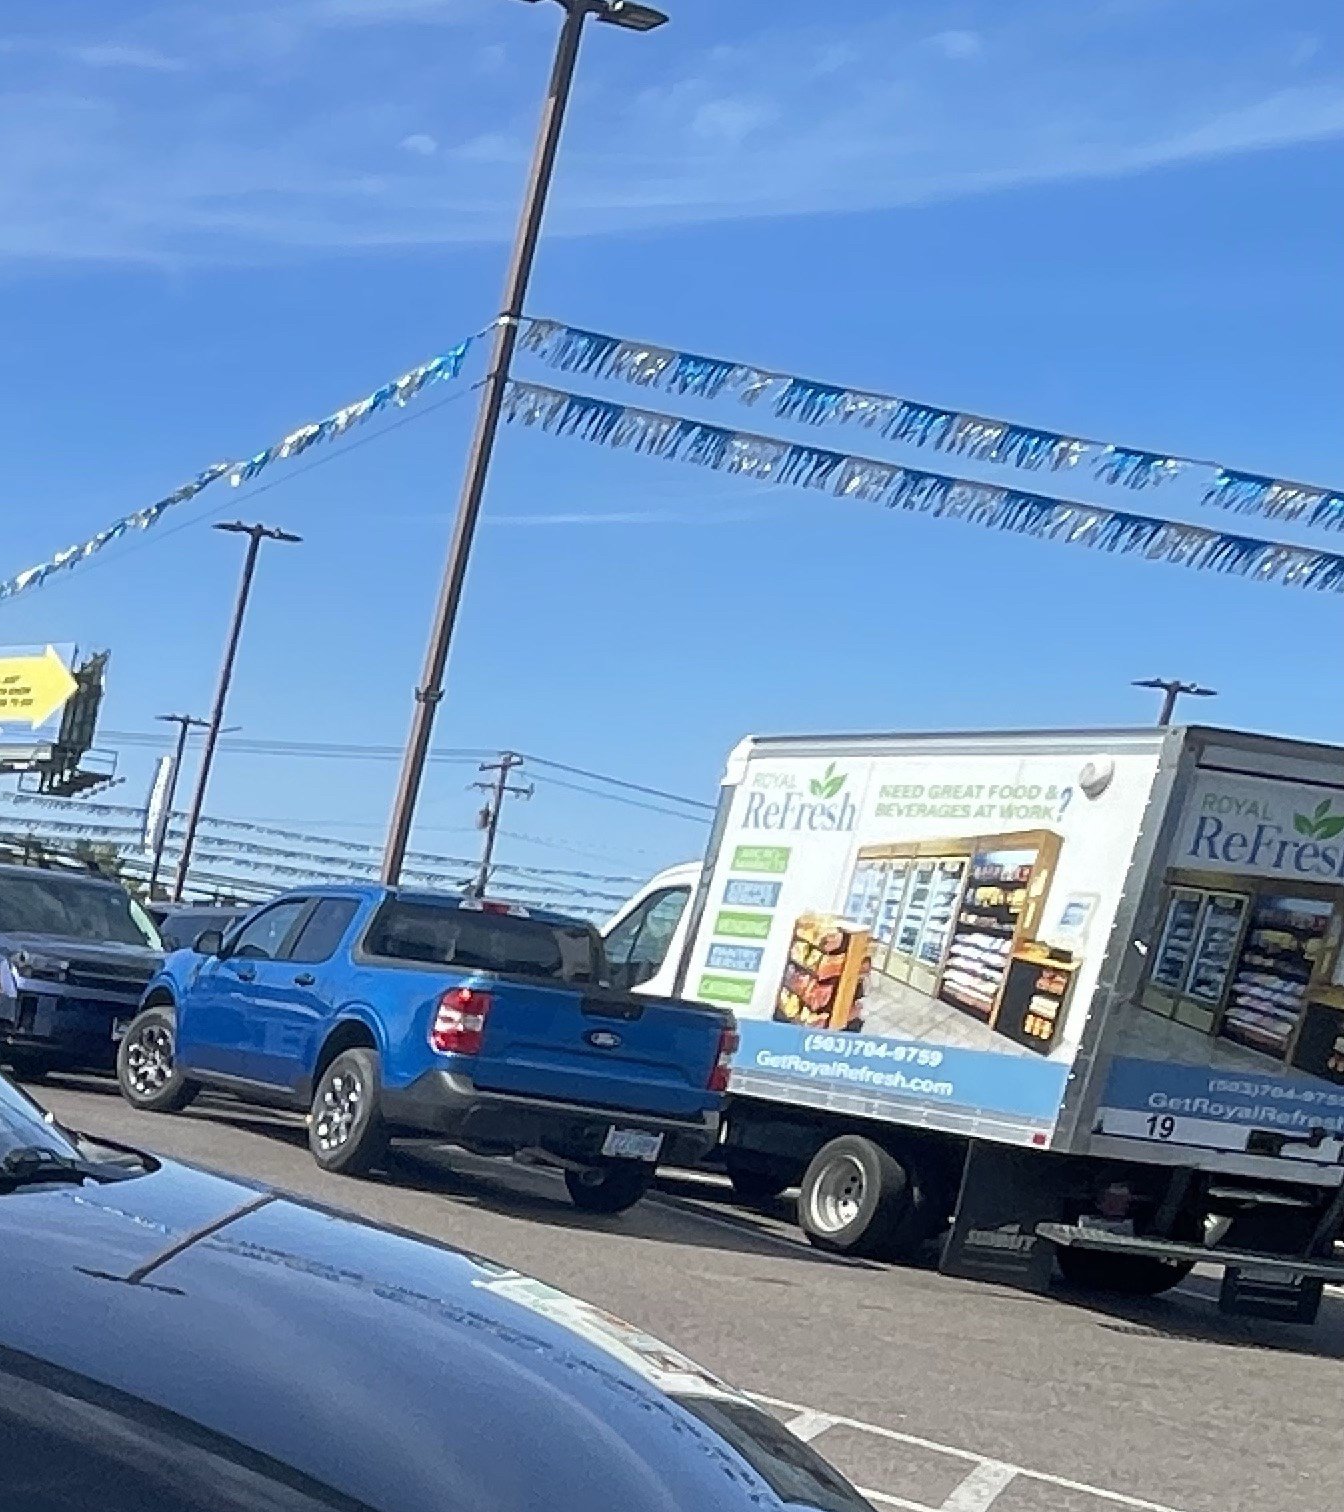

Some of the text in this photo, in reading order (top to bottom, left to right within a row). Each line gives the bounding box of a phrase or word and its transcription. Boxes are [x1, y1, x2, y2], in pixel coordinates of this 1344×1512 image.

[752, 772, 797, 790] ROYAL
[879, 784, 1058, 800] NEED GREAT FOOD &
[741, 791, 857, 832] ReFresh
[874, 803, 971, 818] BEVERAGES
[973, 804, 998, 818] AT
[1200, 792, 1273, 822] ROYAL
[756, 1050, 954, 1096] GetRoyalRefresh.com
[1146, 1115, 1176, 1139] 19
